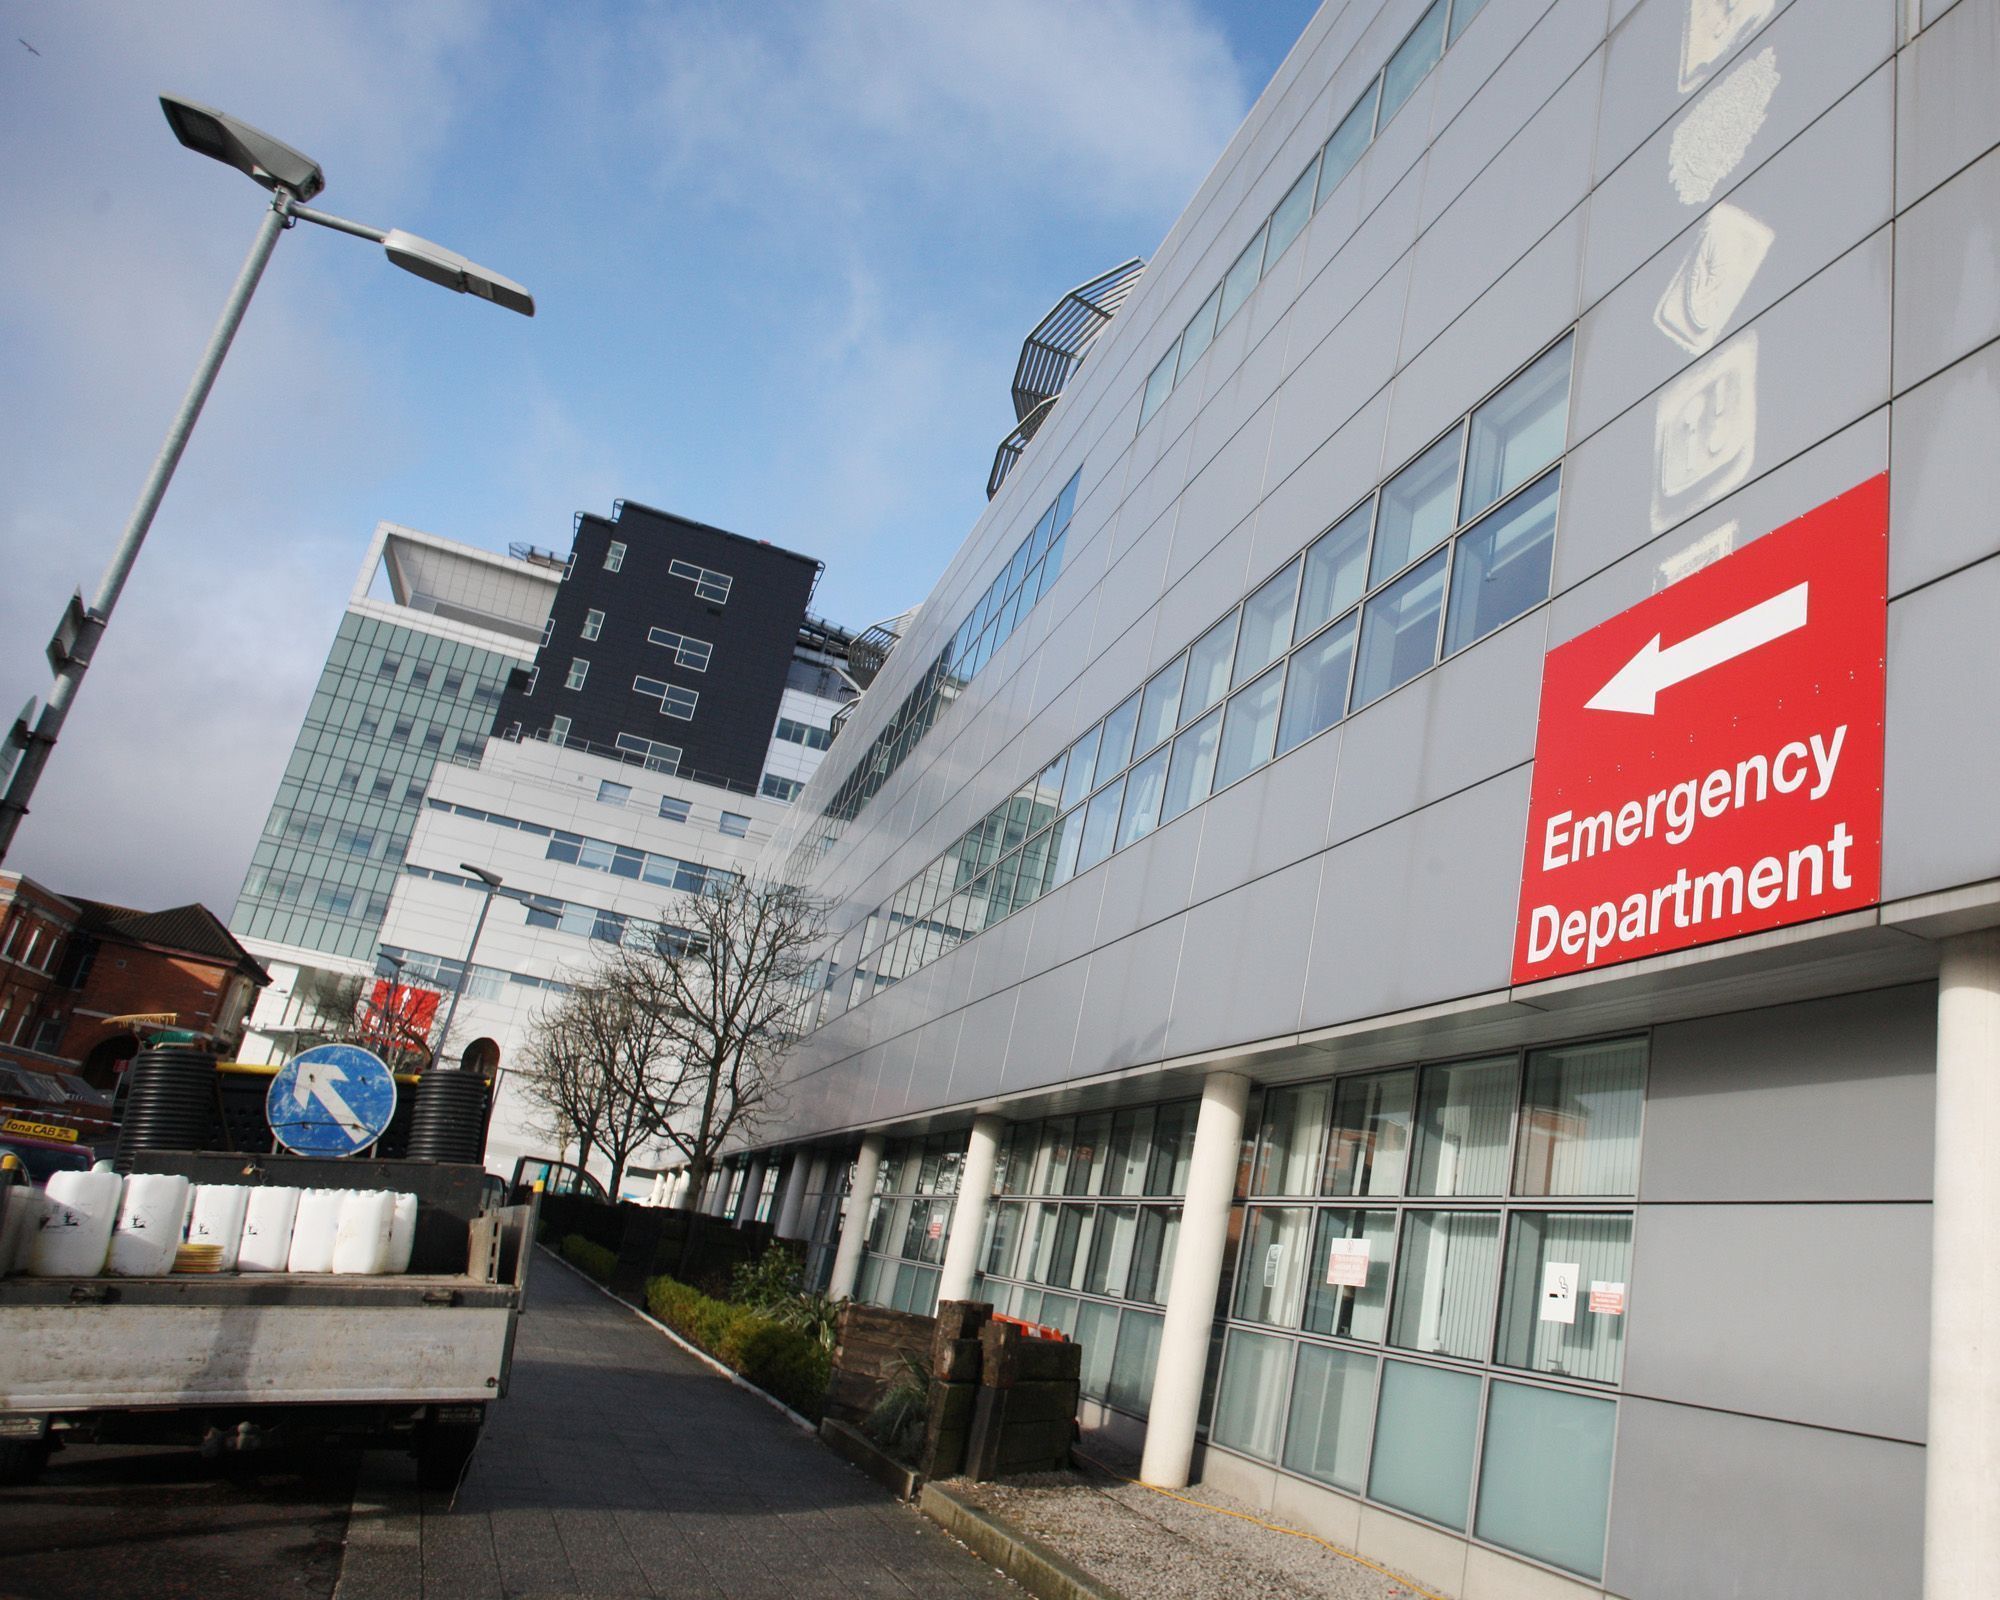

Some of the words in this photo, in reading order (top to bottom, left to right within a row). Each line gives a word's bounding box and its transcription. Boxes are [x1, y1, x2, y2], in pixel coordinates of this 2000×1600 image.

[1542, 724, 1848, 872] Emergency
[1527, 822, 1854, 964] Department
[6, 1120, 57, 1136] fonaCAB
